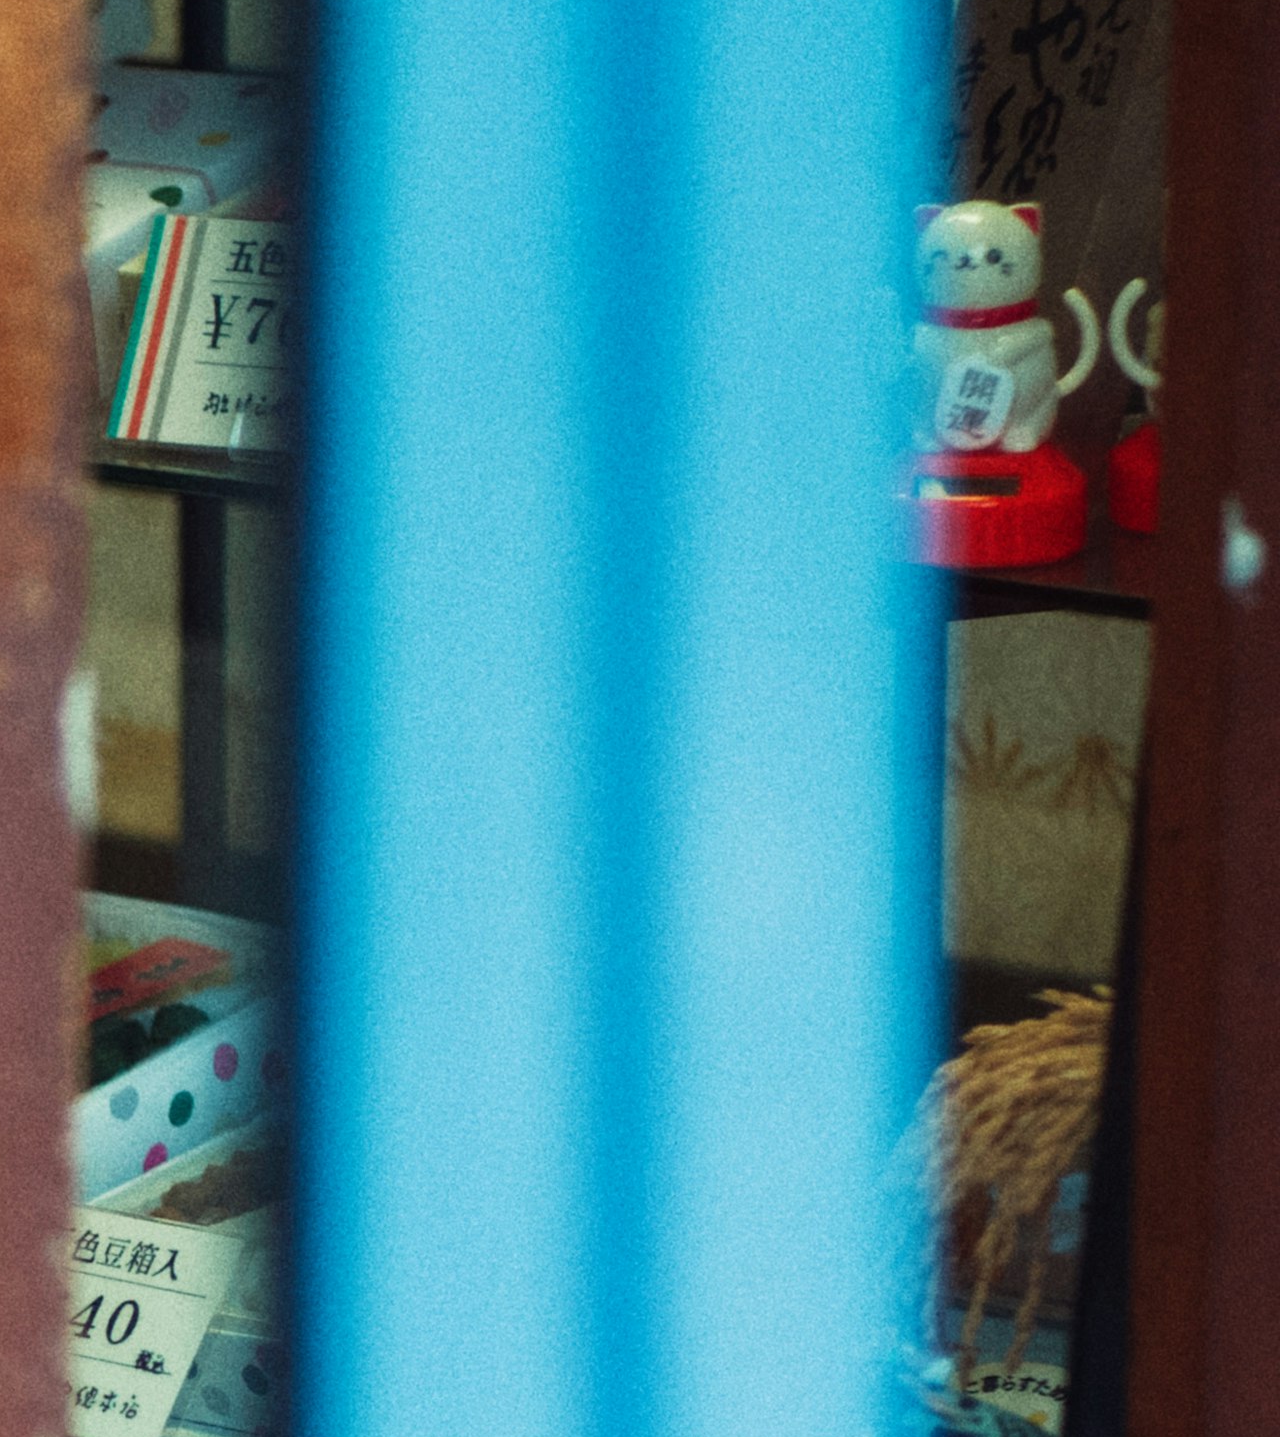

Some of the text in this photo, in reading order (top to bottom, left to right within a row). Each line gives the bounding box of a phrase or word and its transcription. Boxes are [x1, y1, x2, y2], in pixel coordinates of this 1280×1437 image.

[202, 293, 289, 350] ¥7
[947, 368, 1002, 440] 開運
[68, 1228, 180, 1282] 色豆箱入
